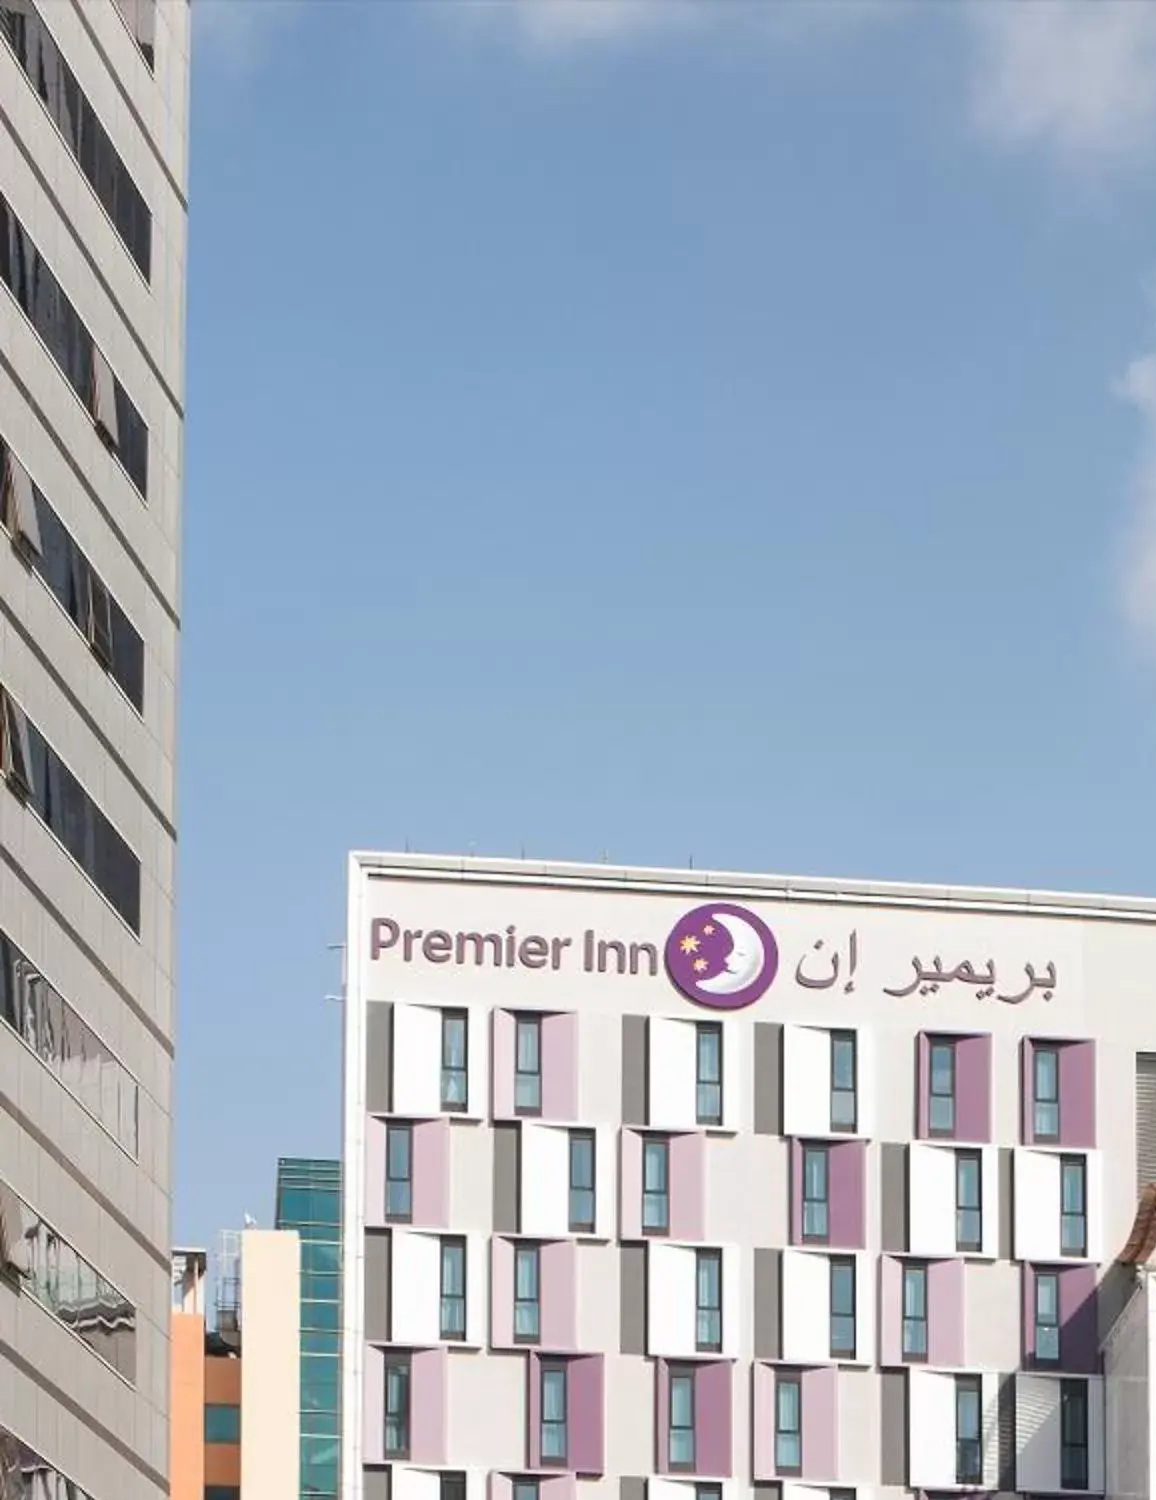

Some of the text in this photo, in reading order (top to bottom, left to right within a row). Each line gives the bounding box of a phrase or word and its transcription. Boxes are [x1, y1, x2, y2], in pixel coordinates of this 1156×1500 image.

[370, 917, 659, 977] Premier Inn
[795, 928, 1056, 1005] بريمير إن
